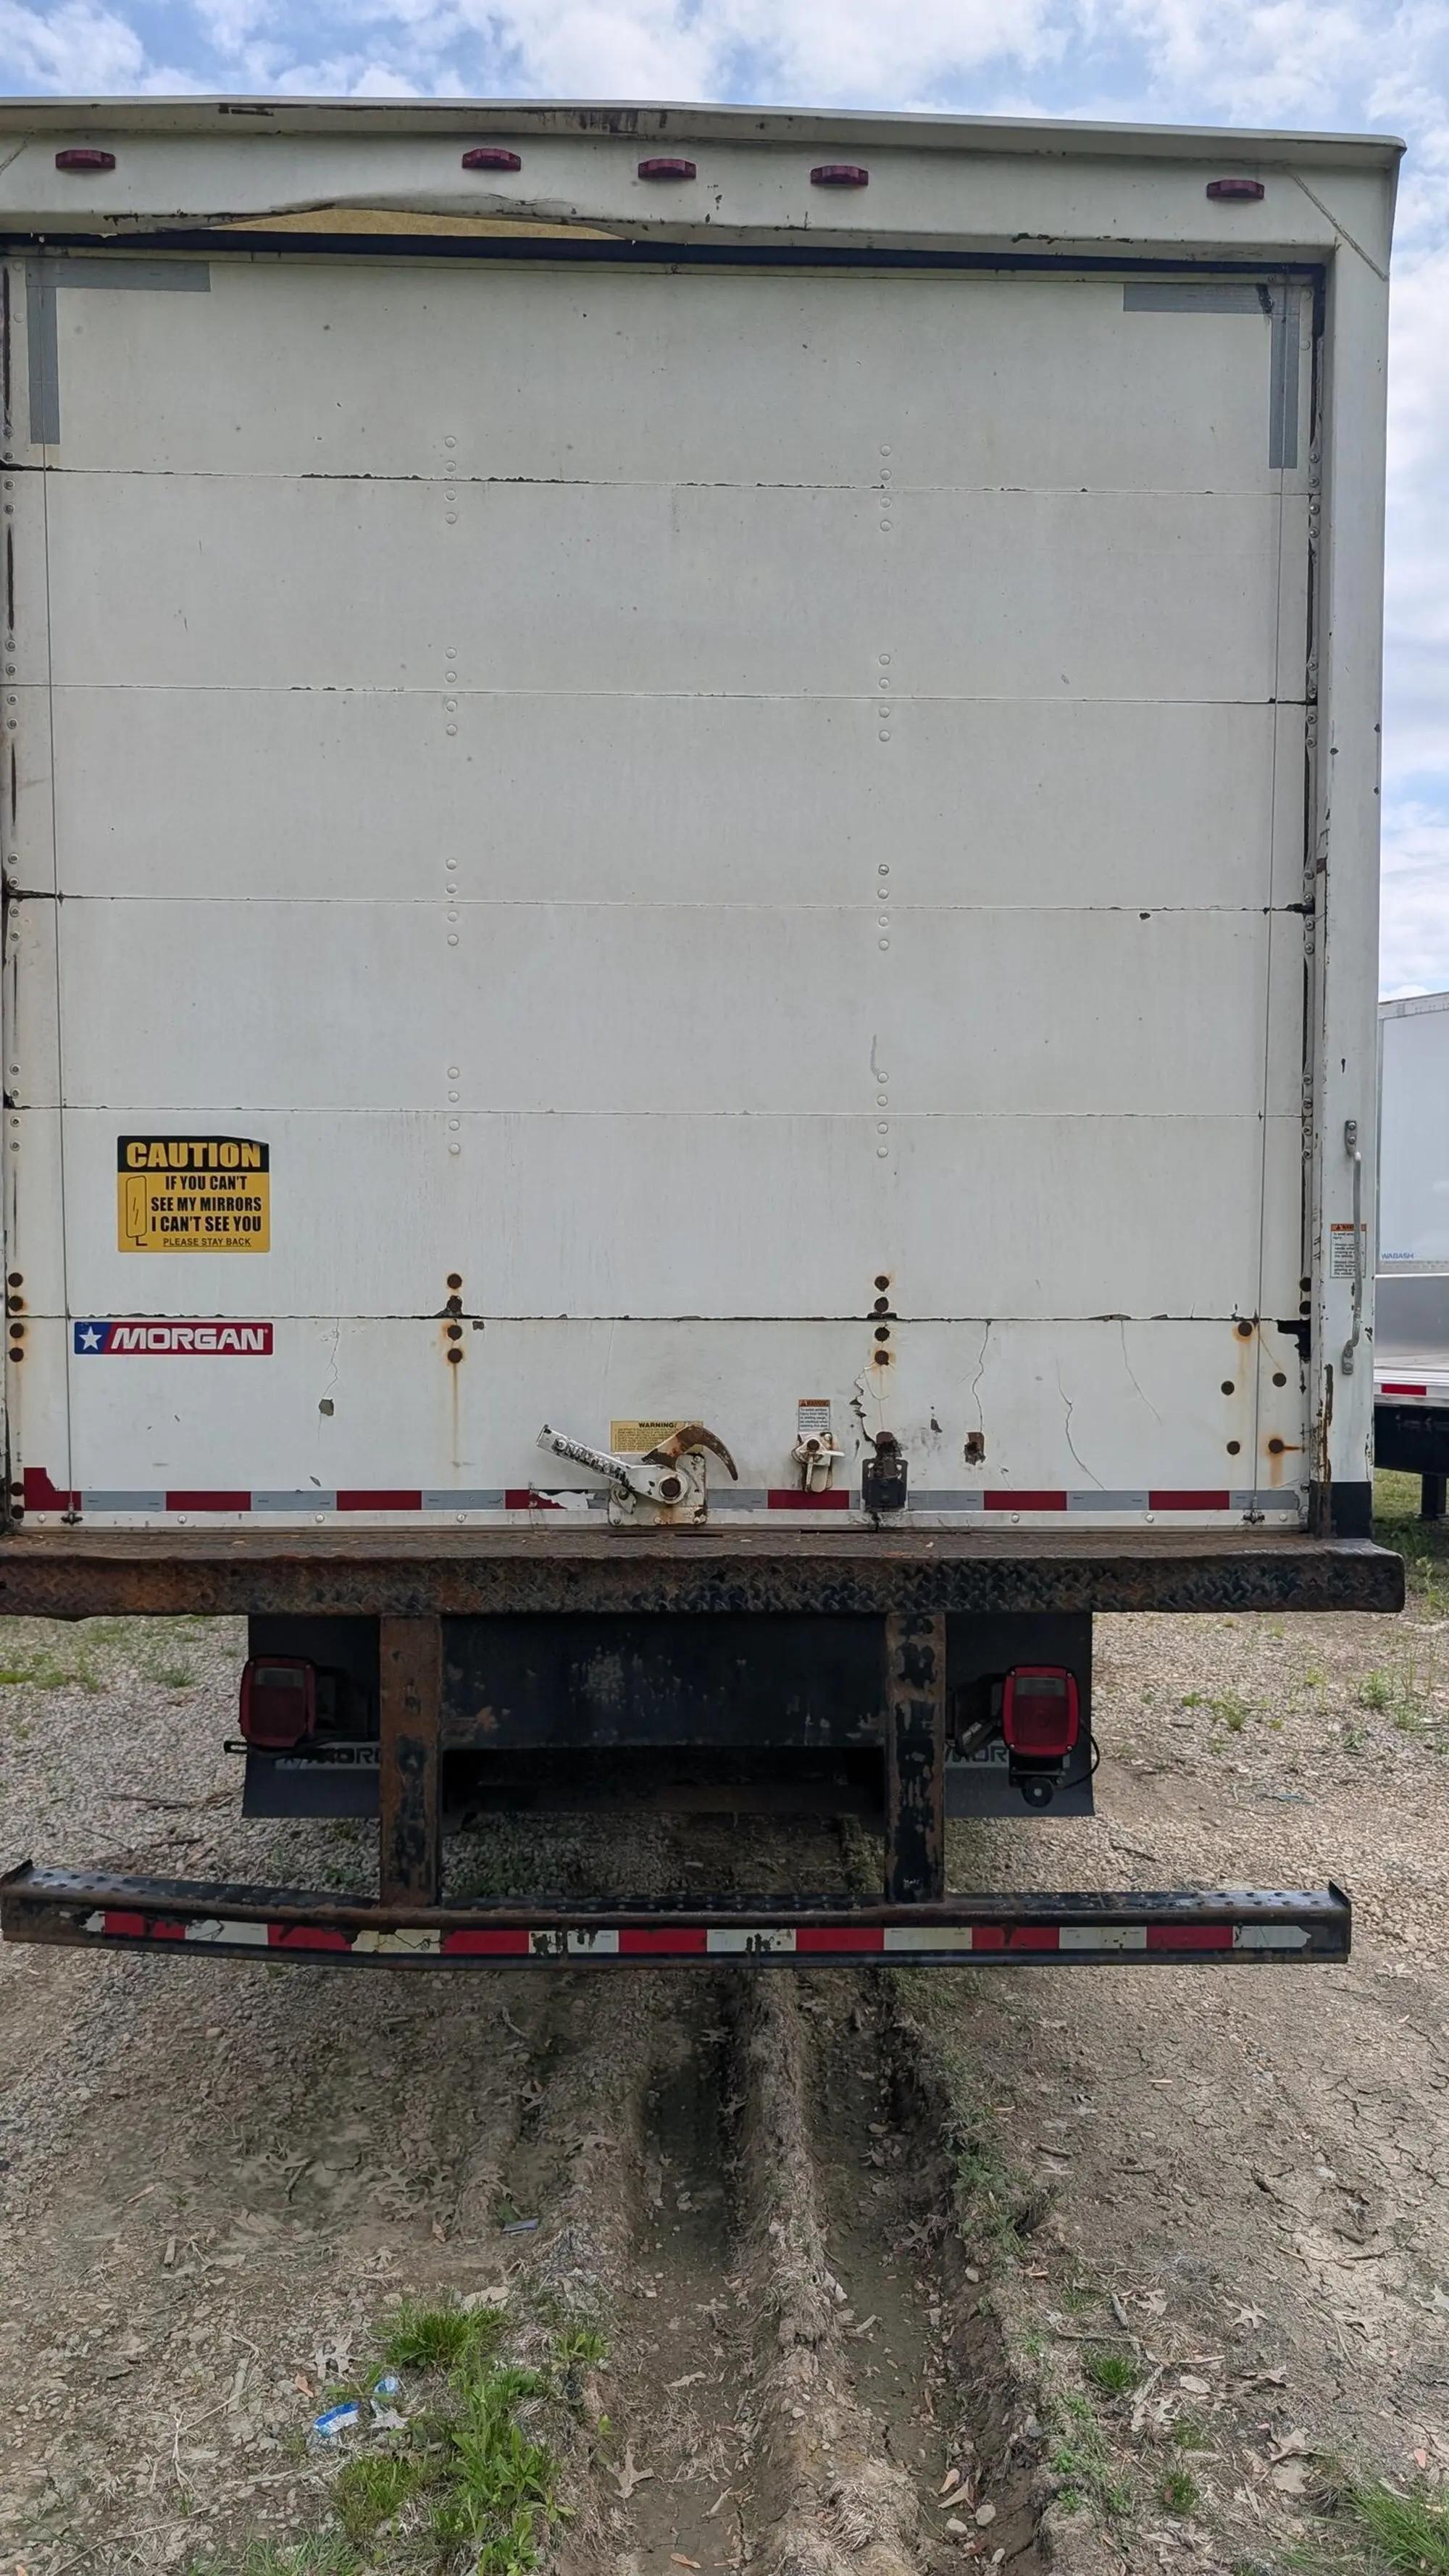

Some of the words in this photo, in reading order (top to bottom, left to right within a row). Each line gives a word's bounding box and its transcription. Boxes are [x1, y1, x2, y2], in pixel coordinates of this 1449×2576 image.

[126, 1142, 261, 1168] CAUTION
[165, 1176, 177, 1190] IF
[180, 1176, 206, 1190] YOU
[210, 1176, 247, 1190] CAN'T
[151, 1197, 174, 1211] SEE
[177, 1197, 197, 1211] MY
[200, 1197, 262, 1212] MIRRORS
[151, 1216, 156, 1231] I
[160, 1216, 201, 1231] CAN'T
[205, 1216, 230, 1231] SEE
[233, 1216, 262, 1231] YOU
[163, 1238, 199, 1247] PLEASE
[201, 1238, 224, 1247] STAY
[226, 1238, 251, 1247] BACK
[111, 1327, 264, 1350] MORGAN
